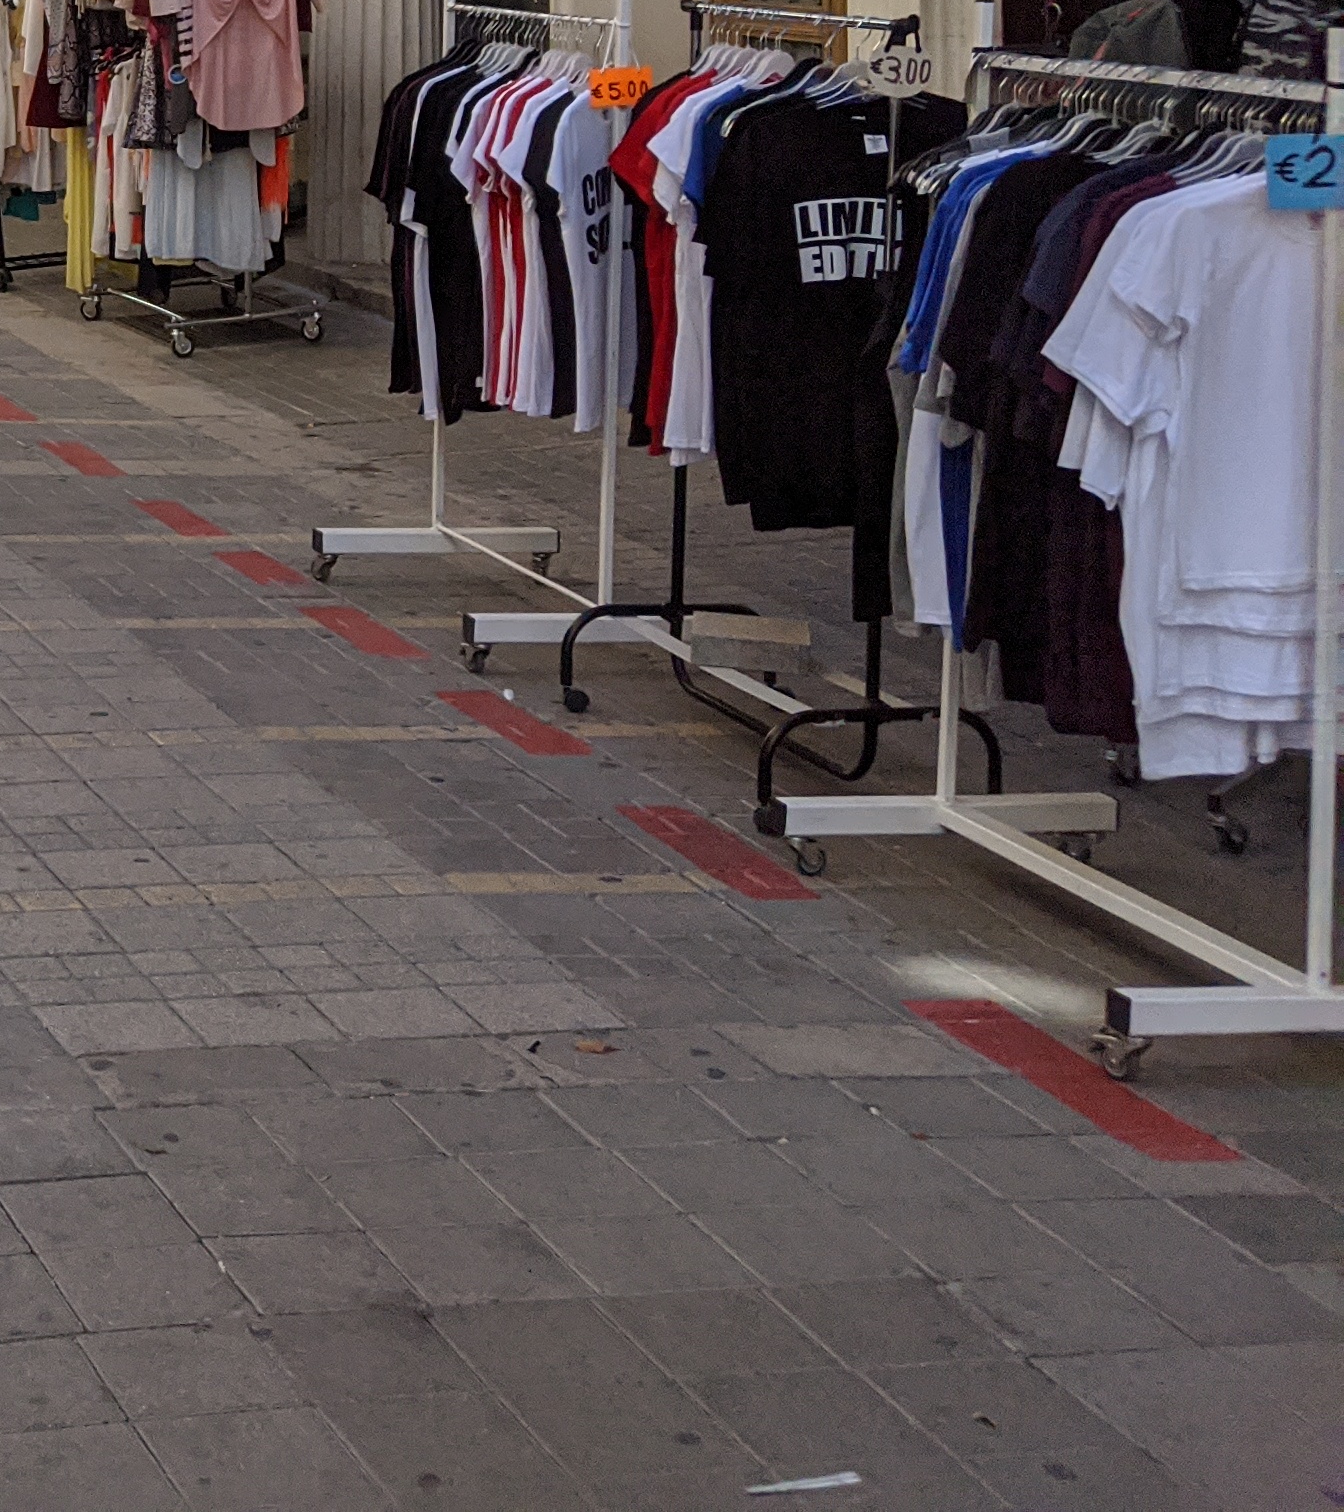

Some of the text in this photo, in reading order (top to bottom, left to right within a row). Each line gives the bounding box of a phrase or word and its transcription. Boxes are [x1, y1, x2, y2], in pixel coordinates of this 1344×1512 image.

[869, 55, 932, 86] €3.00
[590, 79, 649, 101] €5.00
[1272, 144, 1337, 189] €2
